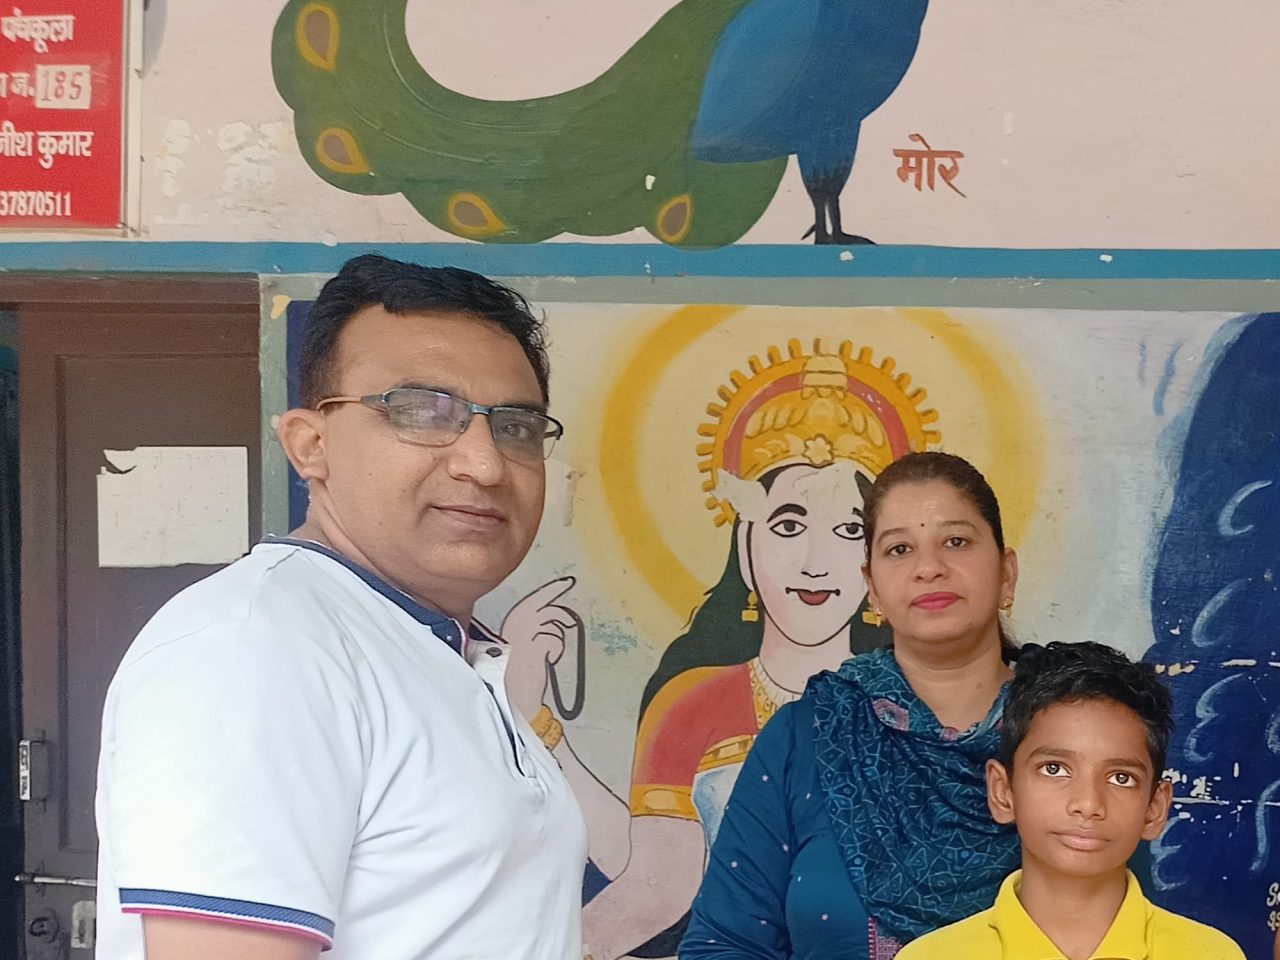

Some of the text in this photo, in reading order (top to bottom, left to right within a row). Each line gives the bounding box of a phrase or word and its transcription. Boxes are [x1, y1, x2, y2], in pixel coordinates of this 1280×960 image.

[41, 70, 83, 101] 185
[37, 131, 94, 169] कुमार
[893, 133, 967, 198] मोर
